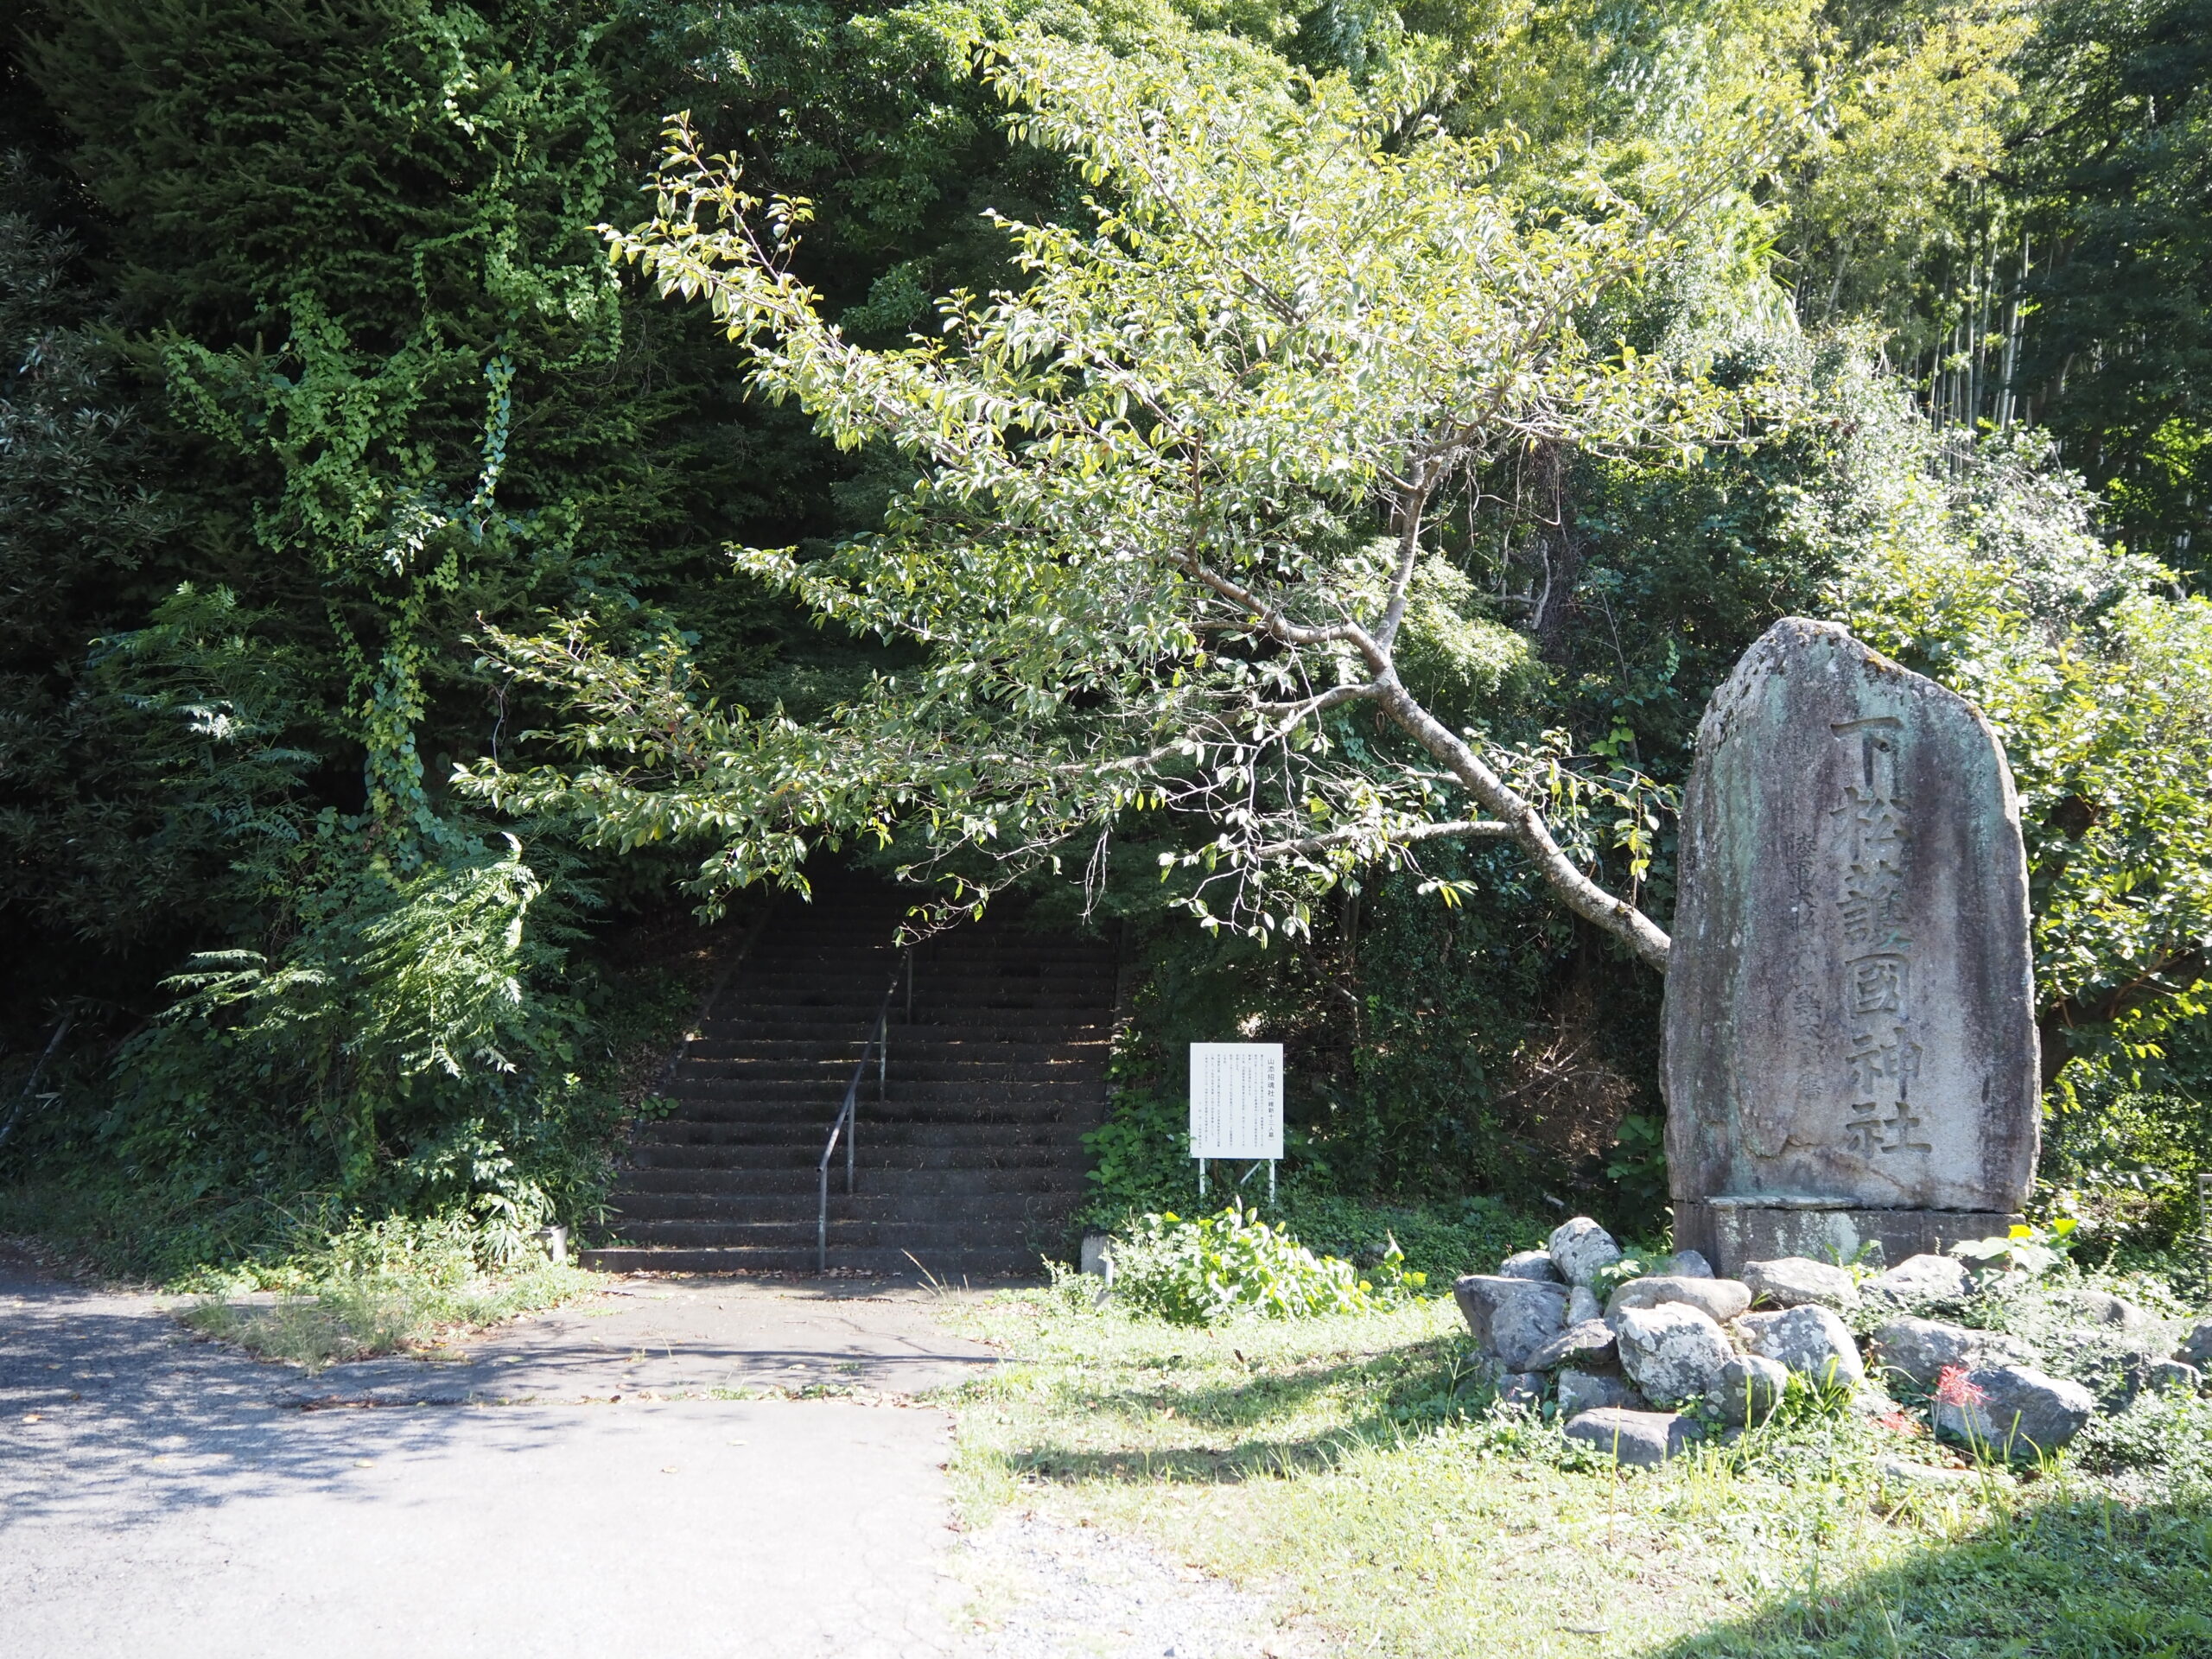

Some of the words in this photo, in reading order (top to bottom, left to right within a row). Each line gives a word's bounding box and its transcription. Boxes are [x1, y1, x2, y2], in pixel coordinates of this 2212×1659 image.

[1830, 716, 1932, 1155] 下松護國神社
